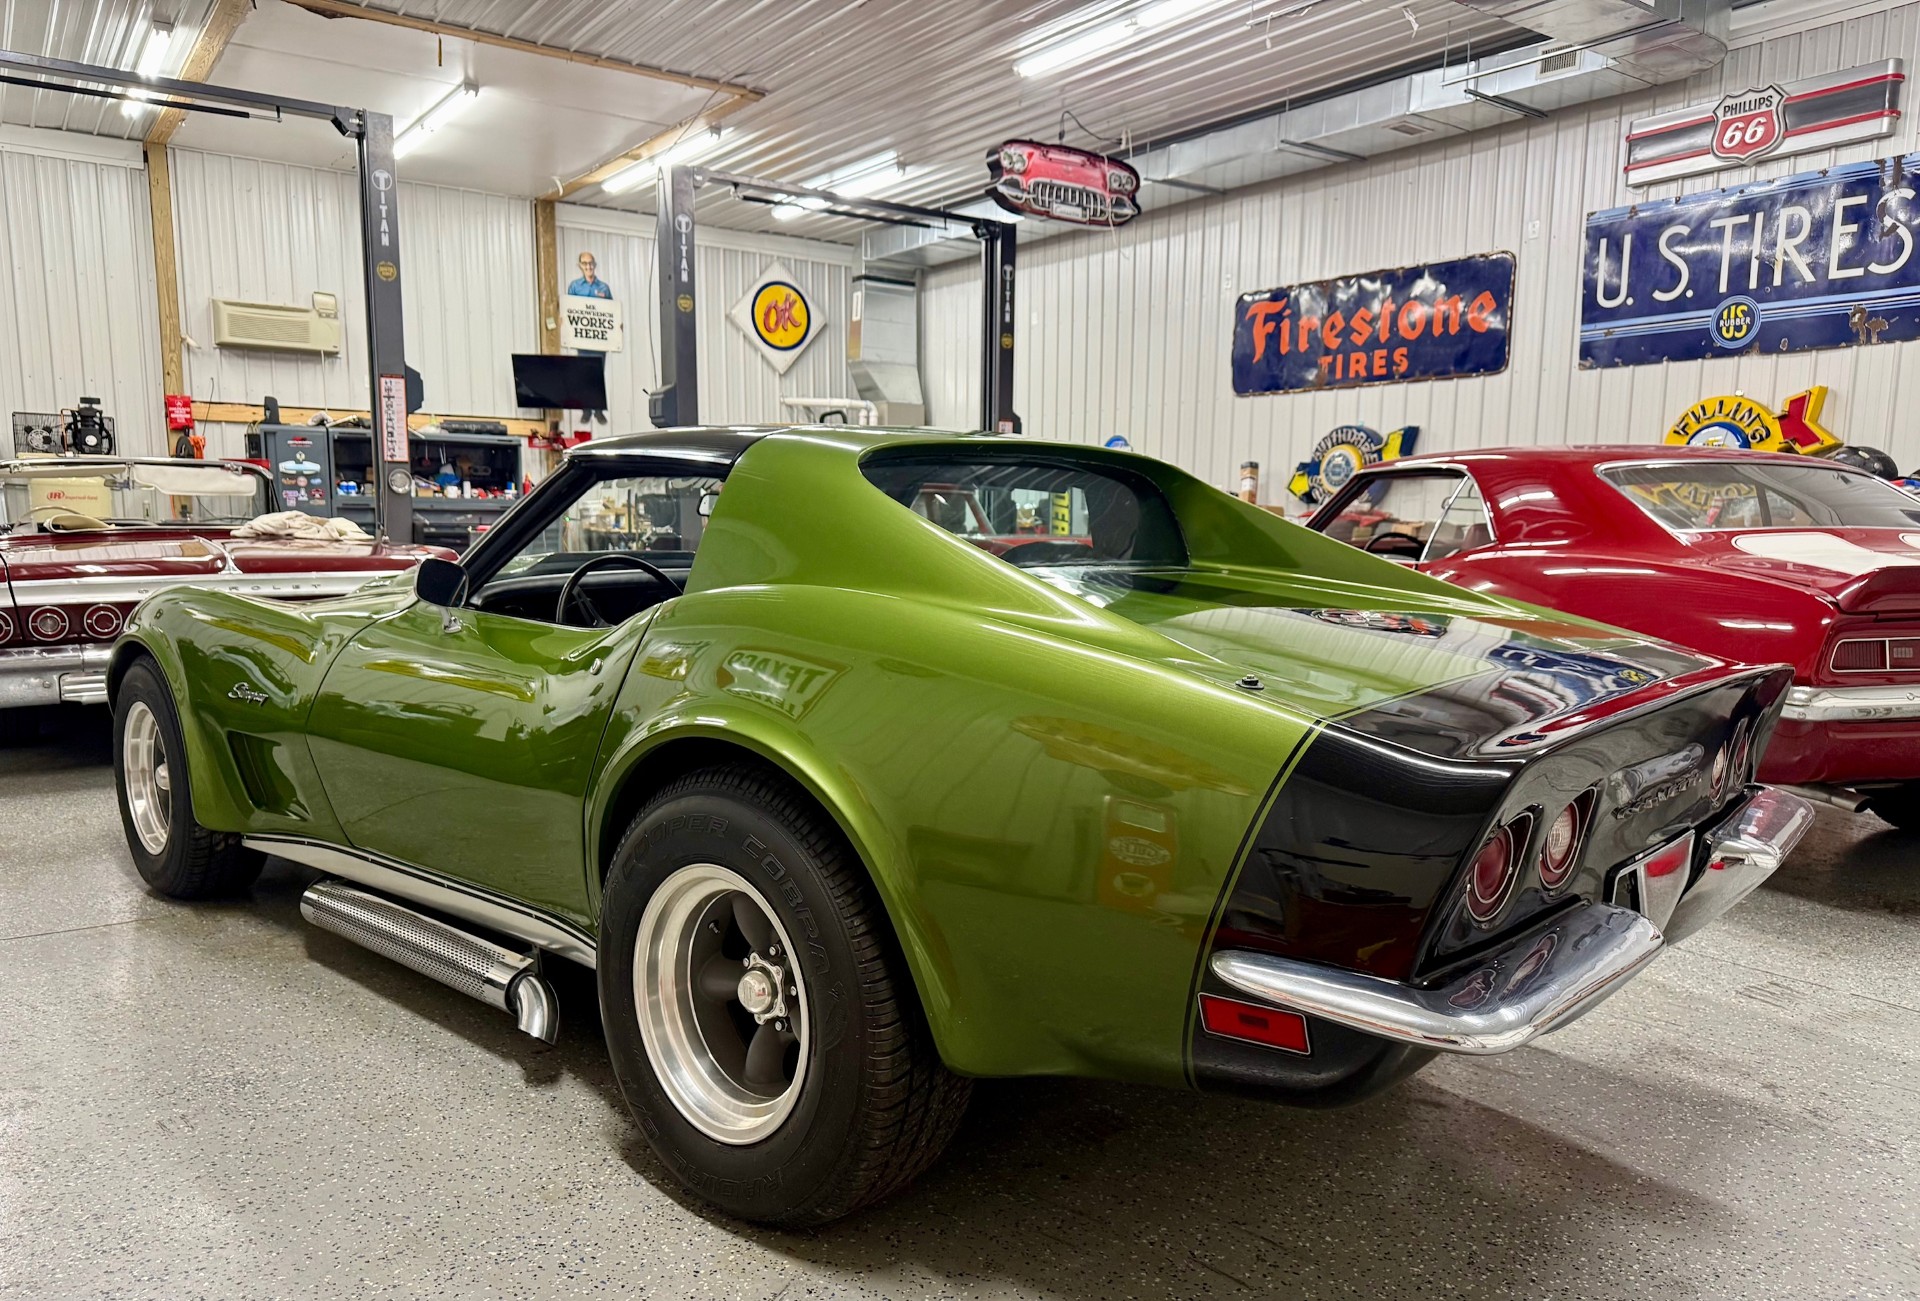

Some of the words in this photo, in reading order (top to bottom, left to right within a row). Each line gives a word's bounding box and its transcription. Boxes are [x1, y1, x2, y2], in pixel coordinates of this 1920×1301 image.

[1723, 95, 1773, 117] PHILLIPS
[1722, 116, 1767, 149] 66
[373, 170, 391, 246] TITAN
[676, 214, 691, 282] TITAN
[1710, 187, 1916, 293] TIRES
[763, 293, 802, 333] OK
[1002, 264, 1014, 322] TITAN
[567, 315, 614, 330] WORKS
[574, 328, 608, 340] HERE
[1245, 290, 1496, 363] Firestone
[1719, 316, 1751, 328] RUBBER
[1318, 347, 1409, 379] TIRES
[1673, 400, 1770, 444] FILLING
[741, 834, 830, 976] COBRA
